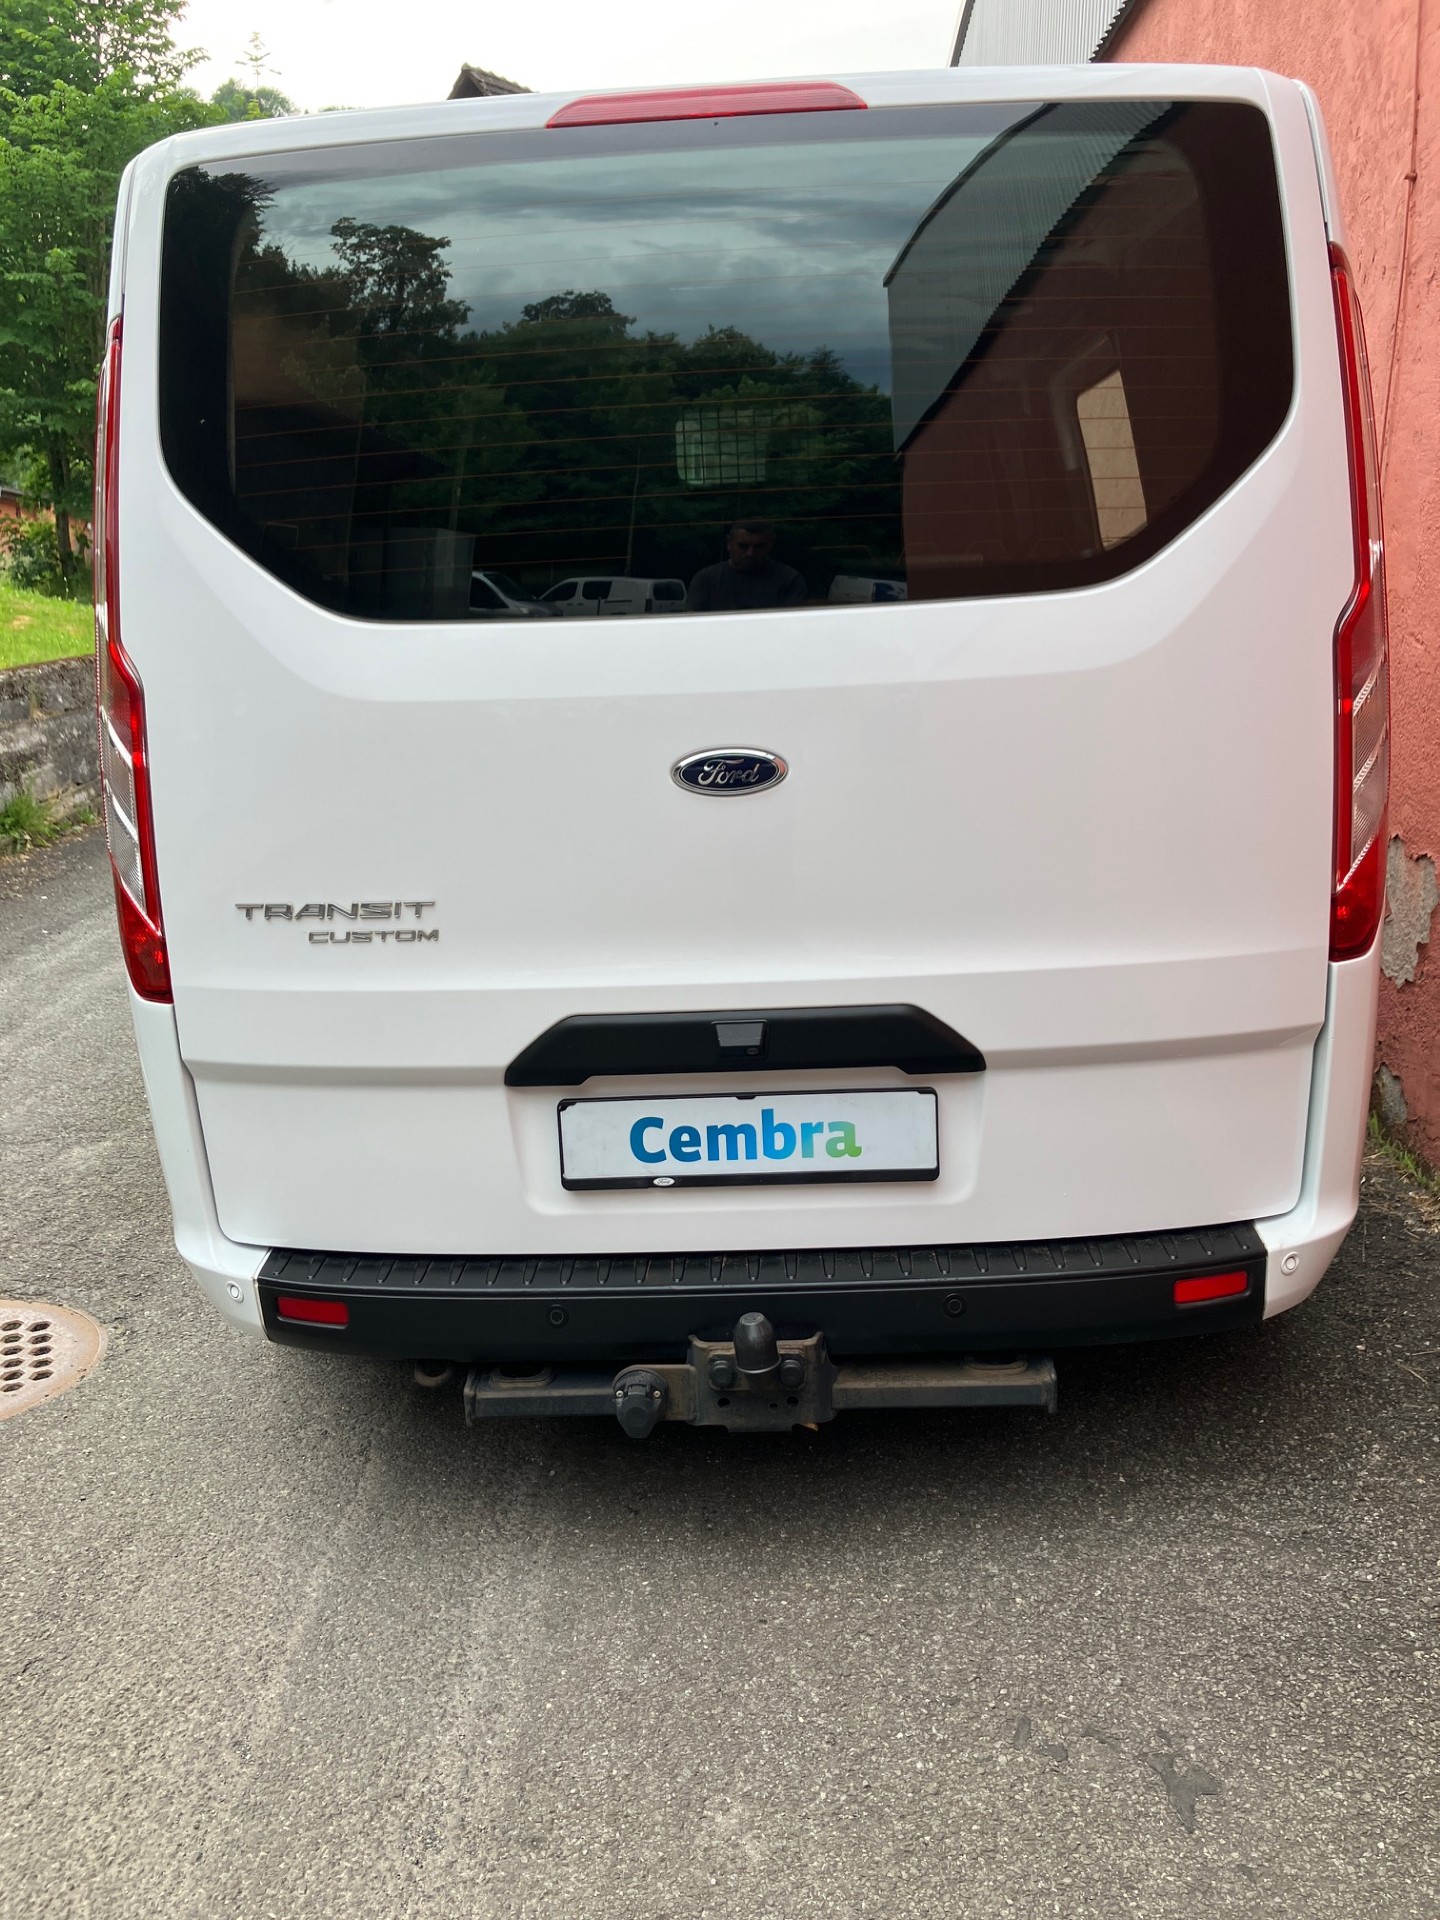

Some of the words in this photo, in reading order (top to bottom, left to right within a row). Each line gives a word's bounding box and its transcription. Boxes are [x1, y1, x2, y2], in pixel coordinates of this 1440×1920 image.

[698, 758, 761, 785] Ford
[234, 901, 436, 920] TRANSIT
[308, 929, 440, 944] CUSTOM
[629, 1107, 863, 1164] Cembra
